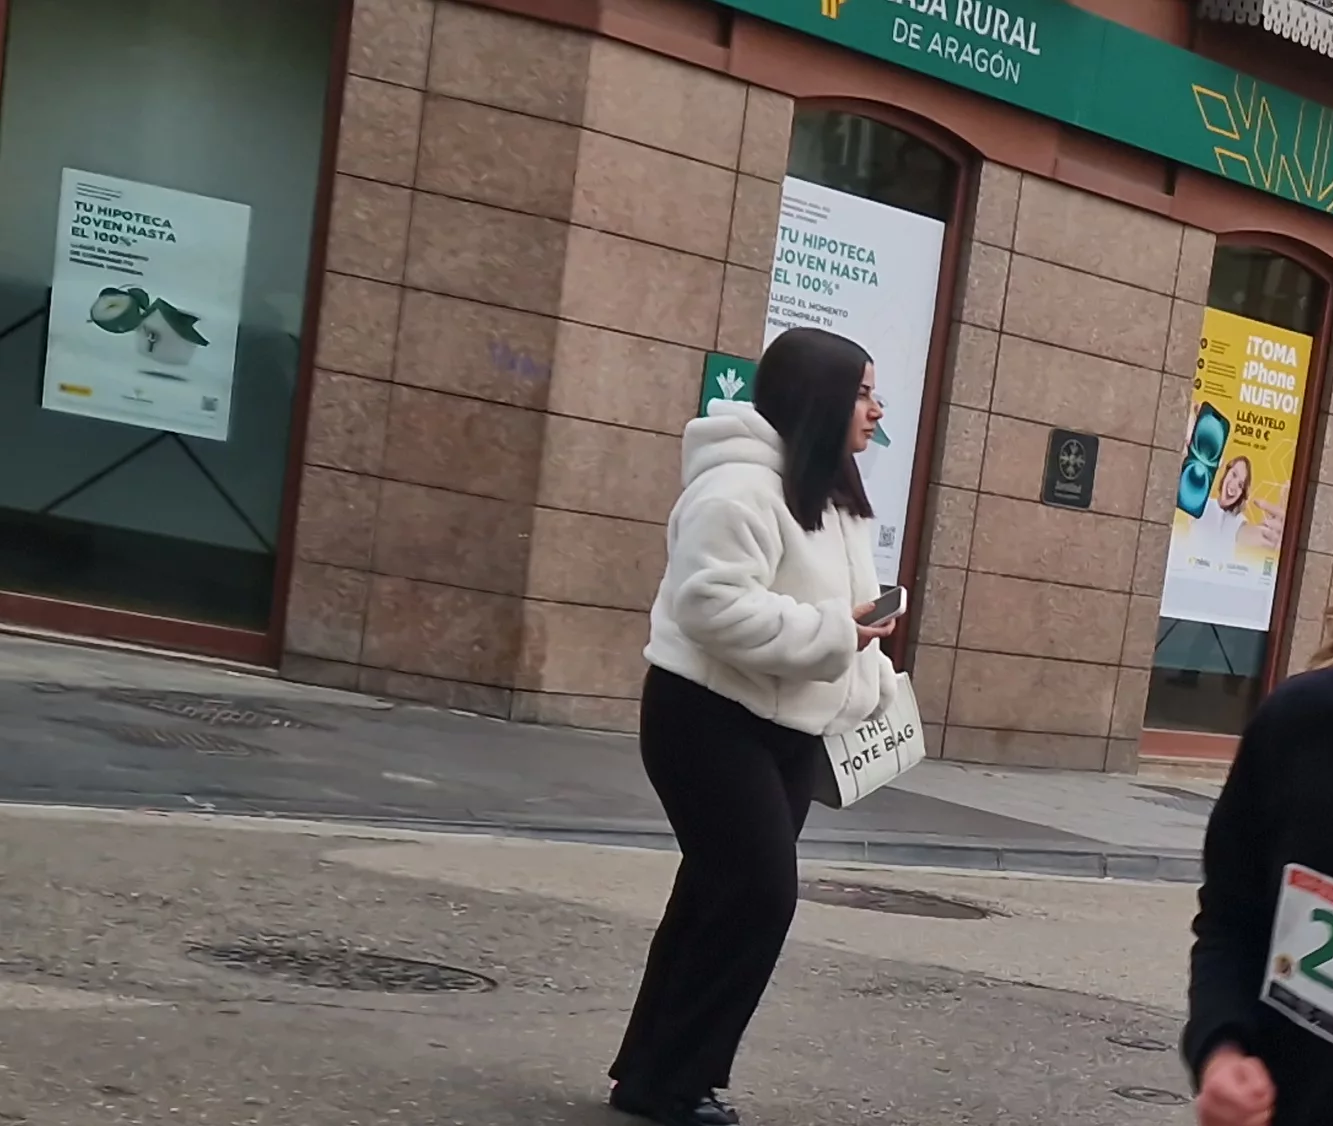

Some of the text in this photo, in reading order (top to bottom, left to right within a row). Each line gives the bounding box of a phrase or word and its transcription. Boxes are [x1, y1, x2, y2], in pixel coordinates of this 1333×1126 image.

[954, 0, 1041, 55] RURAL
[892, 17, 1021, 84] DE ARAGÓN
[72, 213, 176, 243] JOVEN HASTA
[74, 200, 172, 228] TU HIPOTECA
[71, 226, 89, 238] EL
[780, 225, 876, 265] TU HIPOTECA
[774, 267, 791, 285] EL
[776, 247, 878, 287] JOVEN HASTA
[1246, 335, 1297, 368] ¡TOMA
[1239, 383, 1300, 415] NUEVO!
[1234, 423, 1254, 437] POR
[1236, 409, 1286, 431] LLÉVATELO
[855, 719, 888, 743] THE
[840, 723, 914, 776] TOTE BAG
